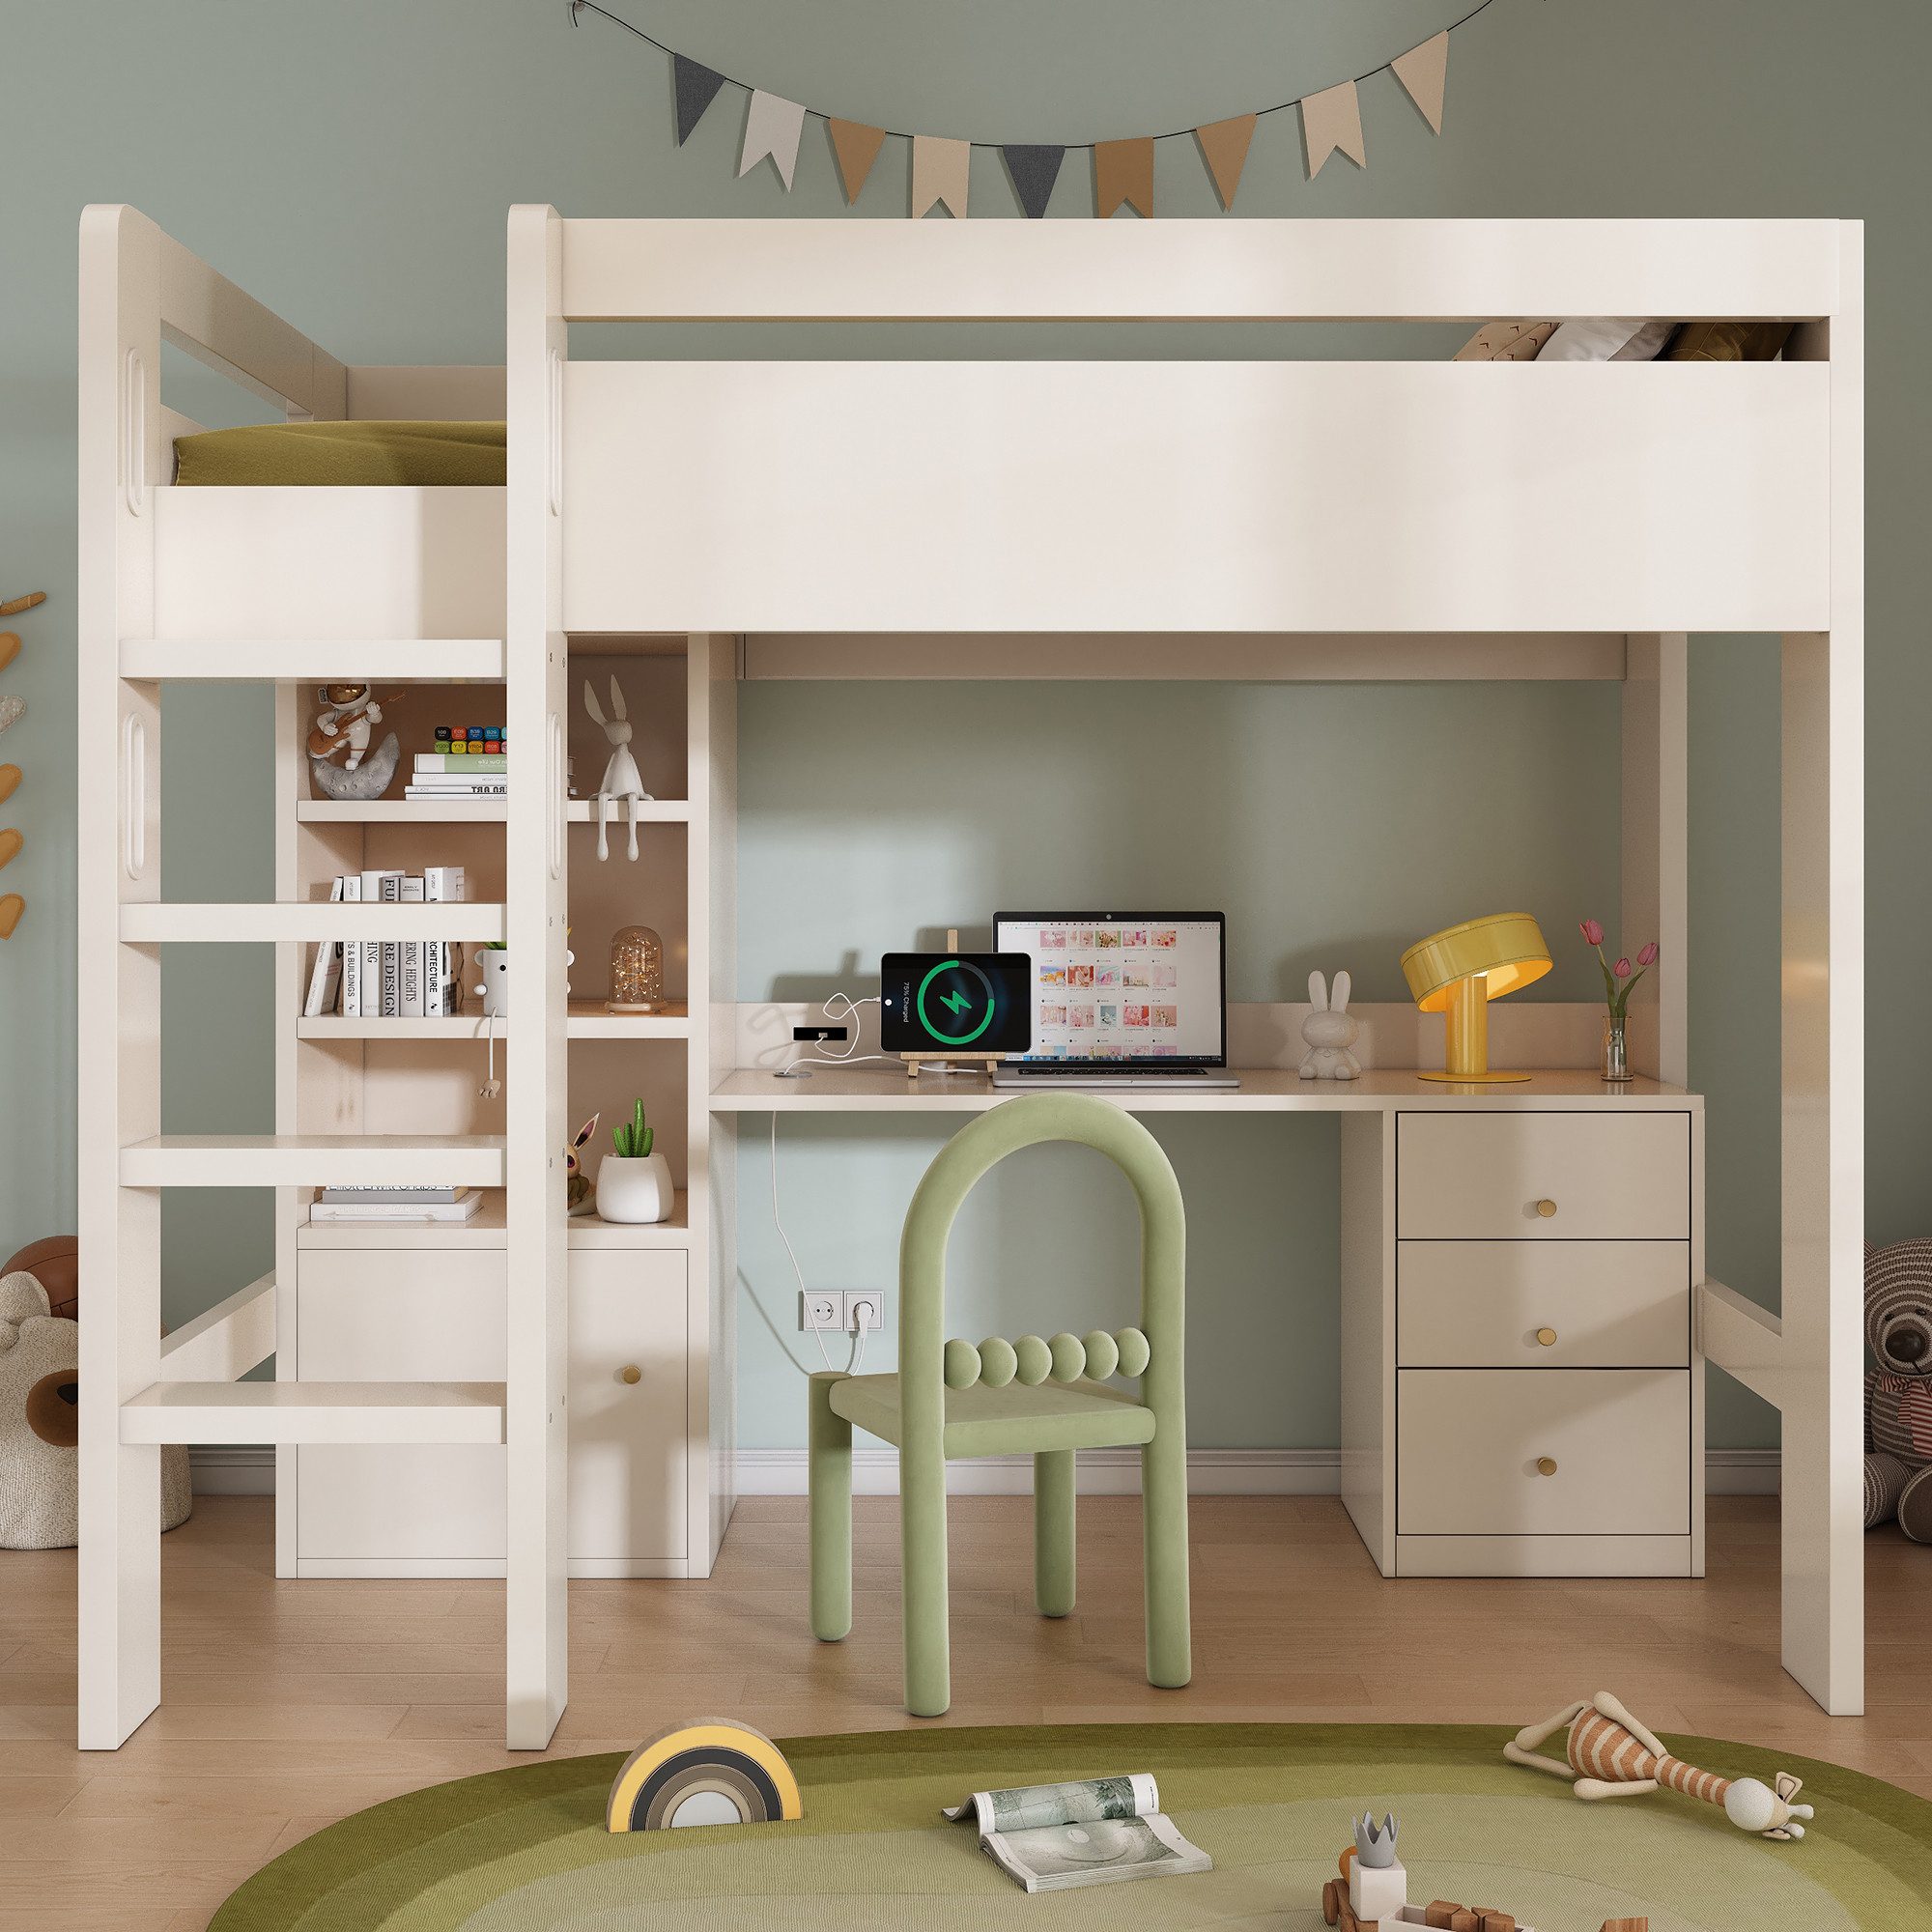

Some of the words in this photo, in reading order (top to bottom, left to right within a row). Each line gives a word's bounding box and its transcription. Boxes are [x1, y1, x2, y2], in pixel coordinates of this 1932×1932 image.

[384, 965, 395, 1016] DESIGN
[406, 968, 417, 1002] HEIGHTS
[429, 941, 438, 993] RCHITECTURE
